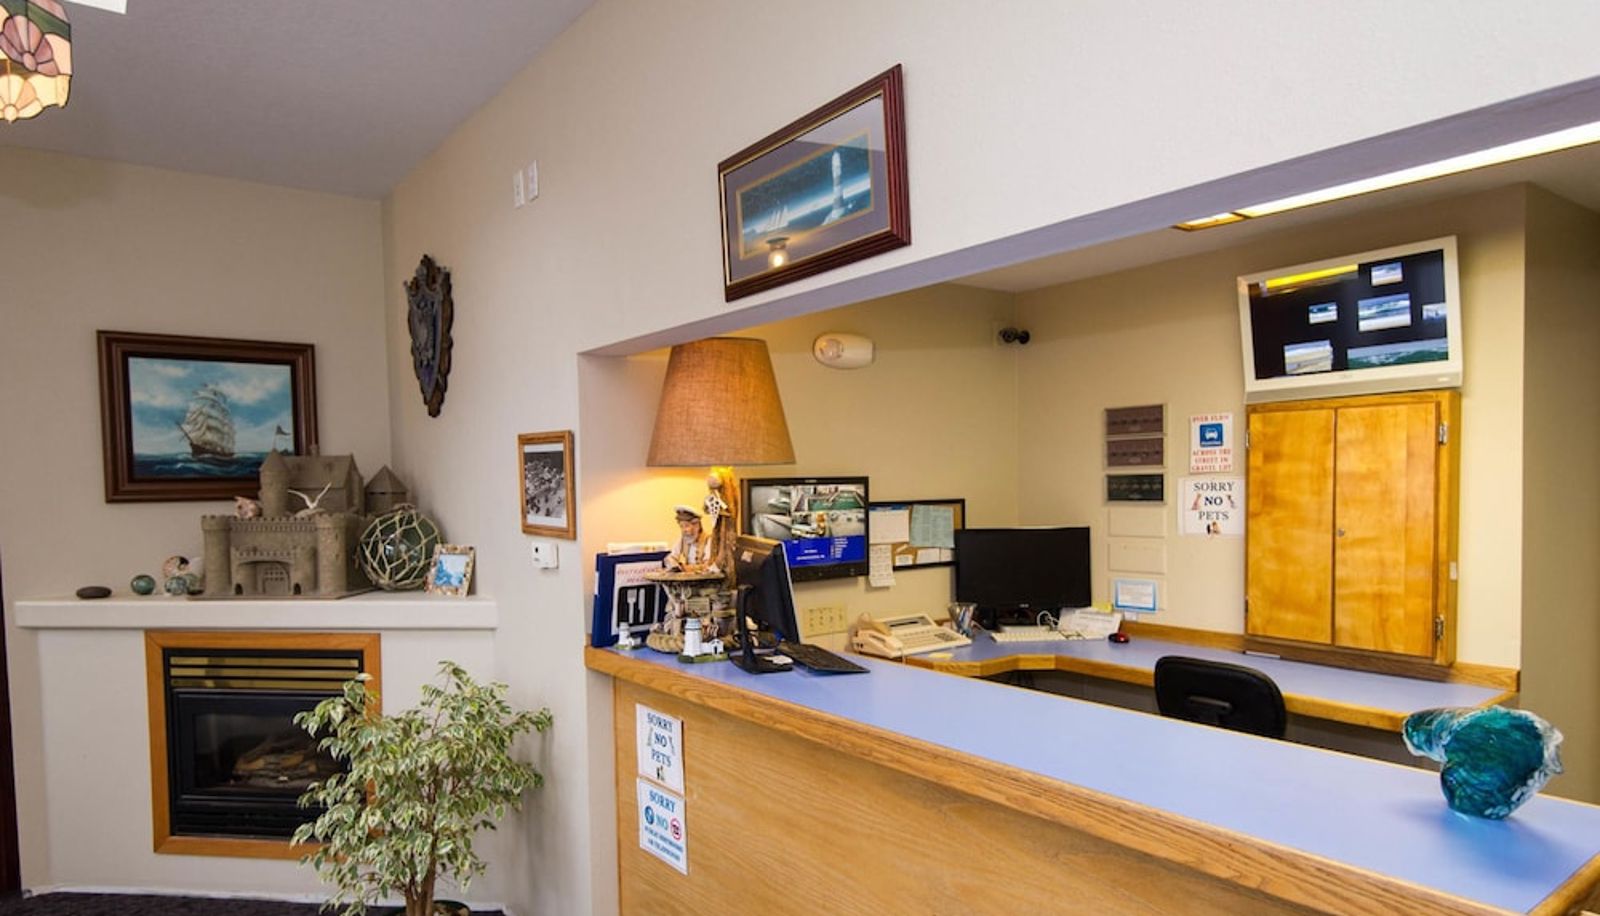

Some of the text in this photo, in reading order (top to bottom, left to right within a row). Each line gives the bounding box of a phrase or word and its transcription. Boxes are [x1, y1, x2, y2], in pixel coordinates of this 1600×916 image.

[1193, 481, 1235, 491] SORRY
[1204, 496, 1223, 506] NO
[1198, 511, 1229, 520] PETS
[647, 712, 673, 733] SORRY
[654, 732, 668, 748] NO
[651, 748, 672, 768] PETS
[649, 789, 676, 813] SORRY
[655, 813, 668, 831] NO
